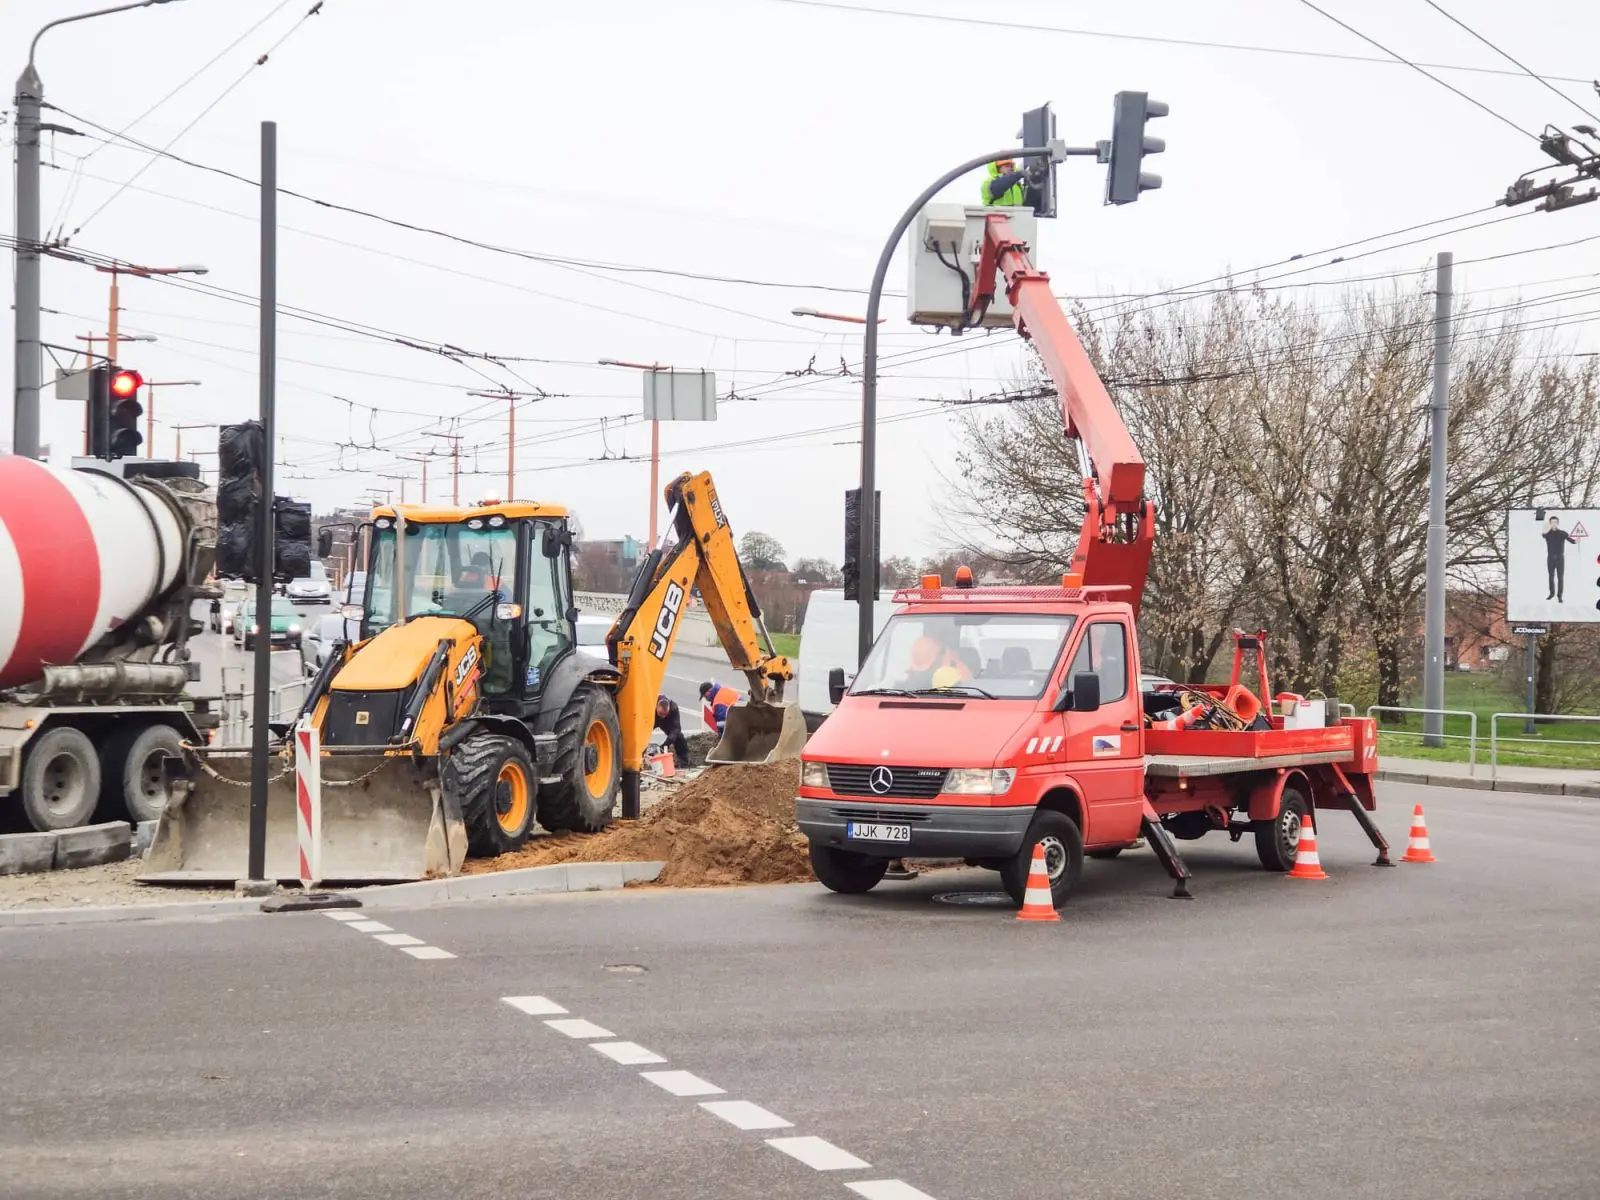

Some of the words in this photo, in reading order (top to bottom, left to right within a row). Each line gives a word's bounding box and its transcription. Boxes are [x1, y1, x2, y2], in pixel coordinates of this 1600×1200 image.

[649, 582, 684, 661] JCB
[455, 645, 477, 686] JCB
[855, 825, 877, 838] JJK
[886, 827, 908, 839] 728
